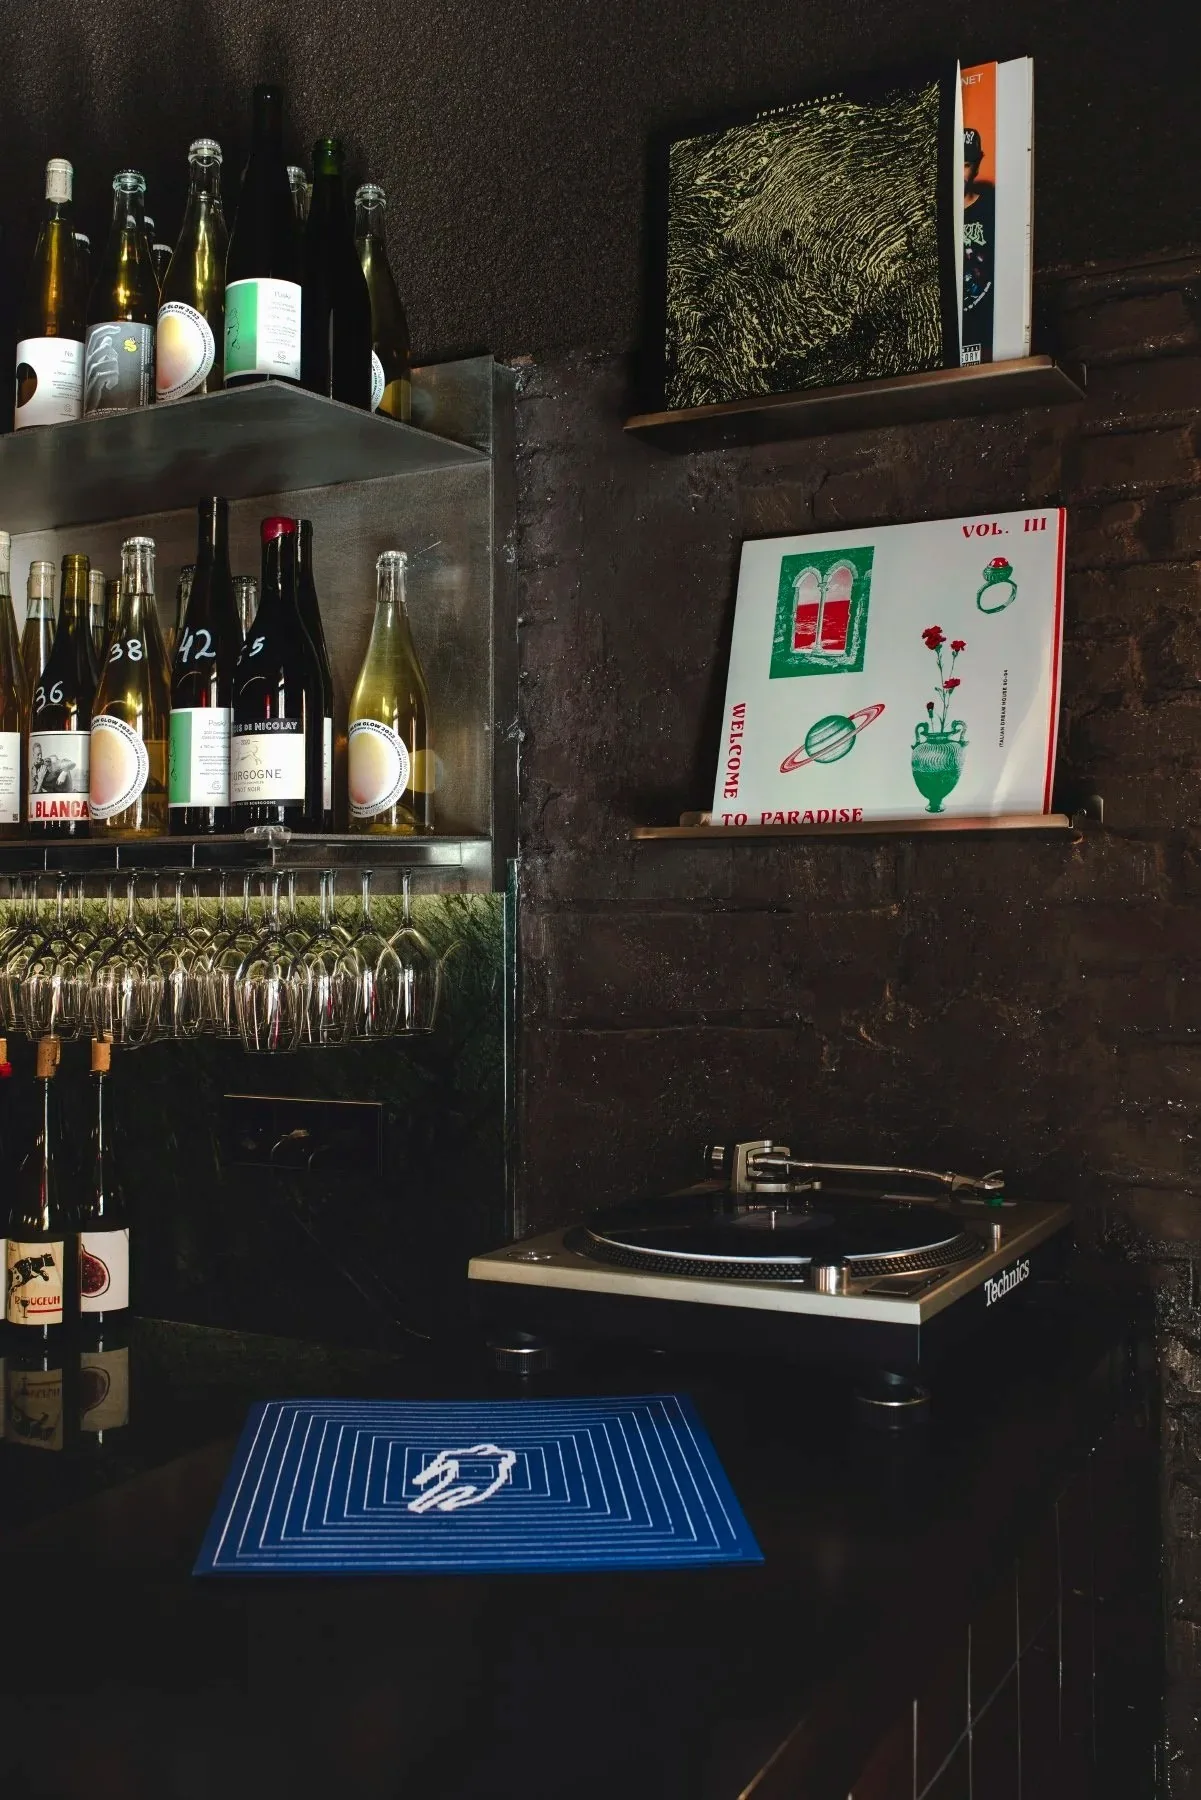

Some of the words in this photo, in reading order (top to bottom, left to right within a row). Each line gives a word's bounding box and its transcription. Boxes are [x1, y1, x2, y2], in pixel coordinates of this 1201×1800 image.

[961, 72, 984, 85] NET
[962, 522, 1009, 538] VOL.
[1024, 517, 1047, 533] III
[109, 639, 143, 663] 38
[179, 627, 217, 663] 42
[36, 680, 64, 713] 36
[244, 723, 253, 731] DE
[254, 721, 298, 731] NICOLAY
[362, 721, 381, 730] GLOW
[380, 726, 396, 739] 2022
[723, 702, 747, 799] WELCOME
[232, 768, 282, 781] URGOGNE
[35, 800, 90, 818] BLANCA
[721, 813, 749, 827] TO
[760, 807, 864, 825] PARADISE
[984, 1259, 1030, 1307] Technics
